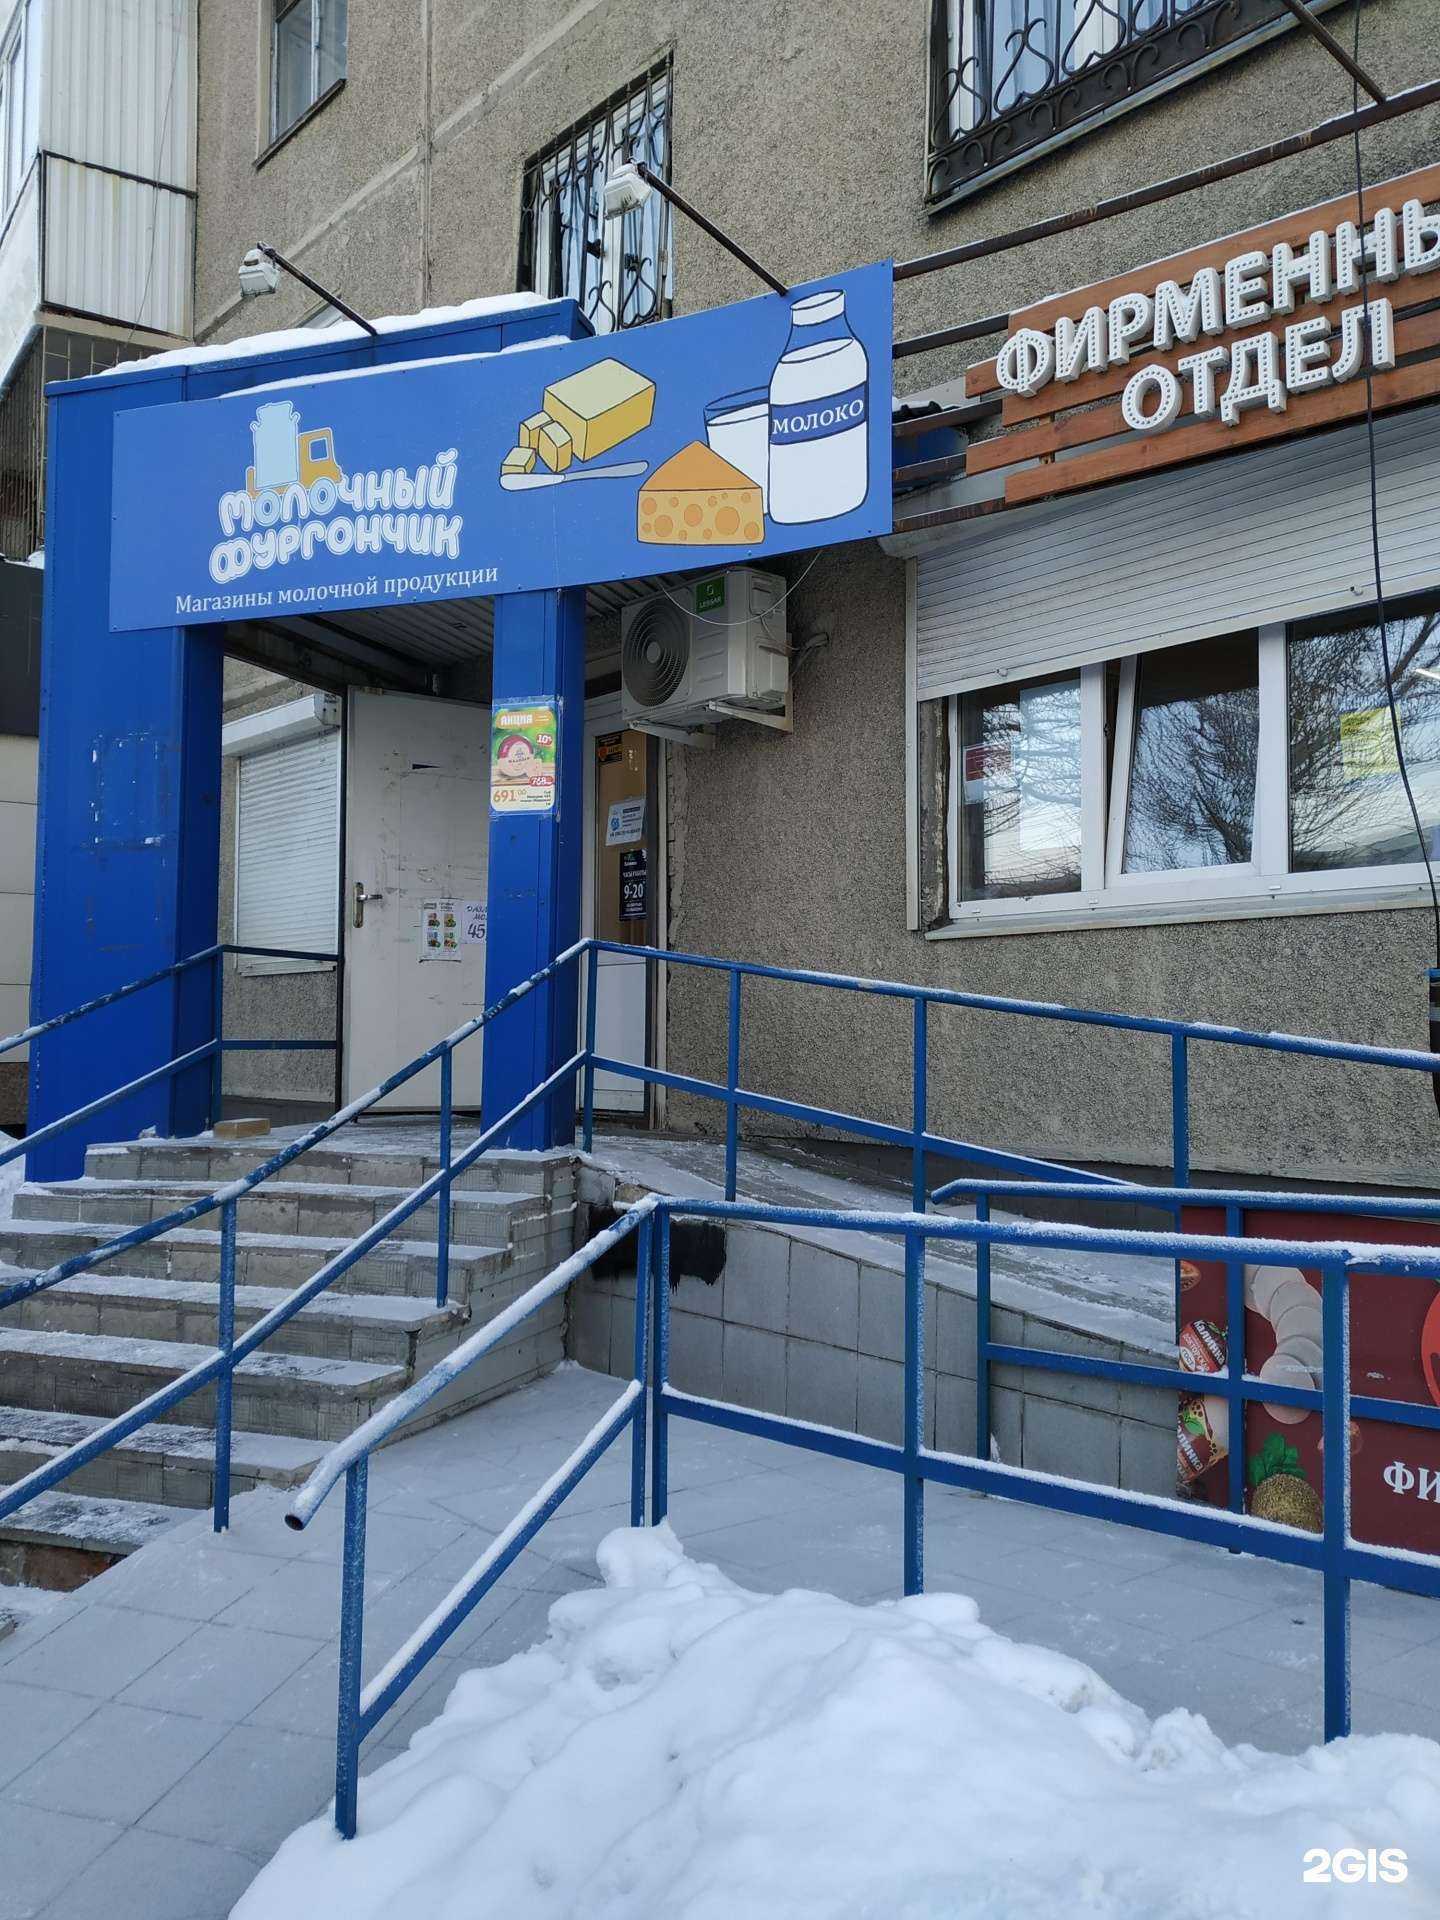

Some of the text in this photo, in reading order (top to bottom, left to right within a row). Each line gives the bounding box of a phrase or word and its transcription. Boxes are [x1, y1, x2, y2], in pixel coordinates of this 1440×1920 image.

[1122, 298, 1395, 434] ОТДЕЛ
[176, 567, 498, 614] Магазины молочной продукции
[493, 790, 517, 803] 691
